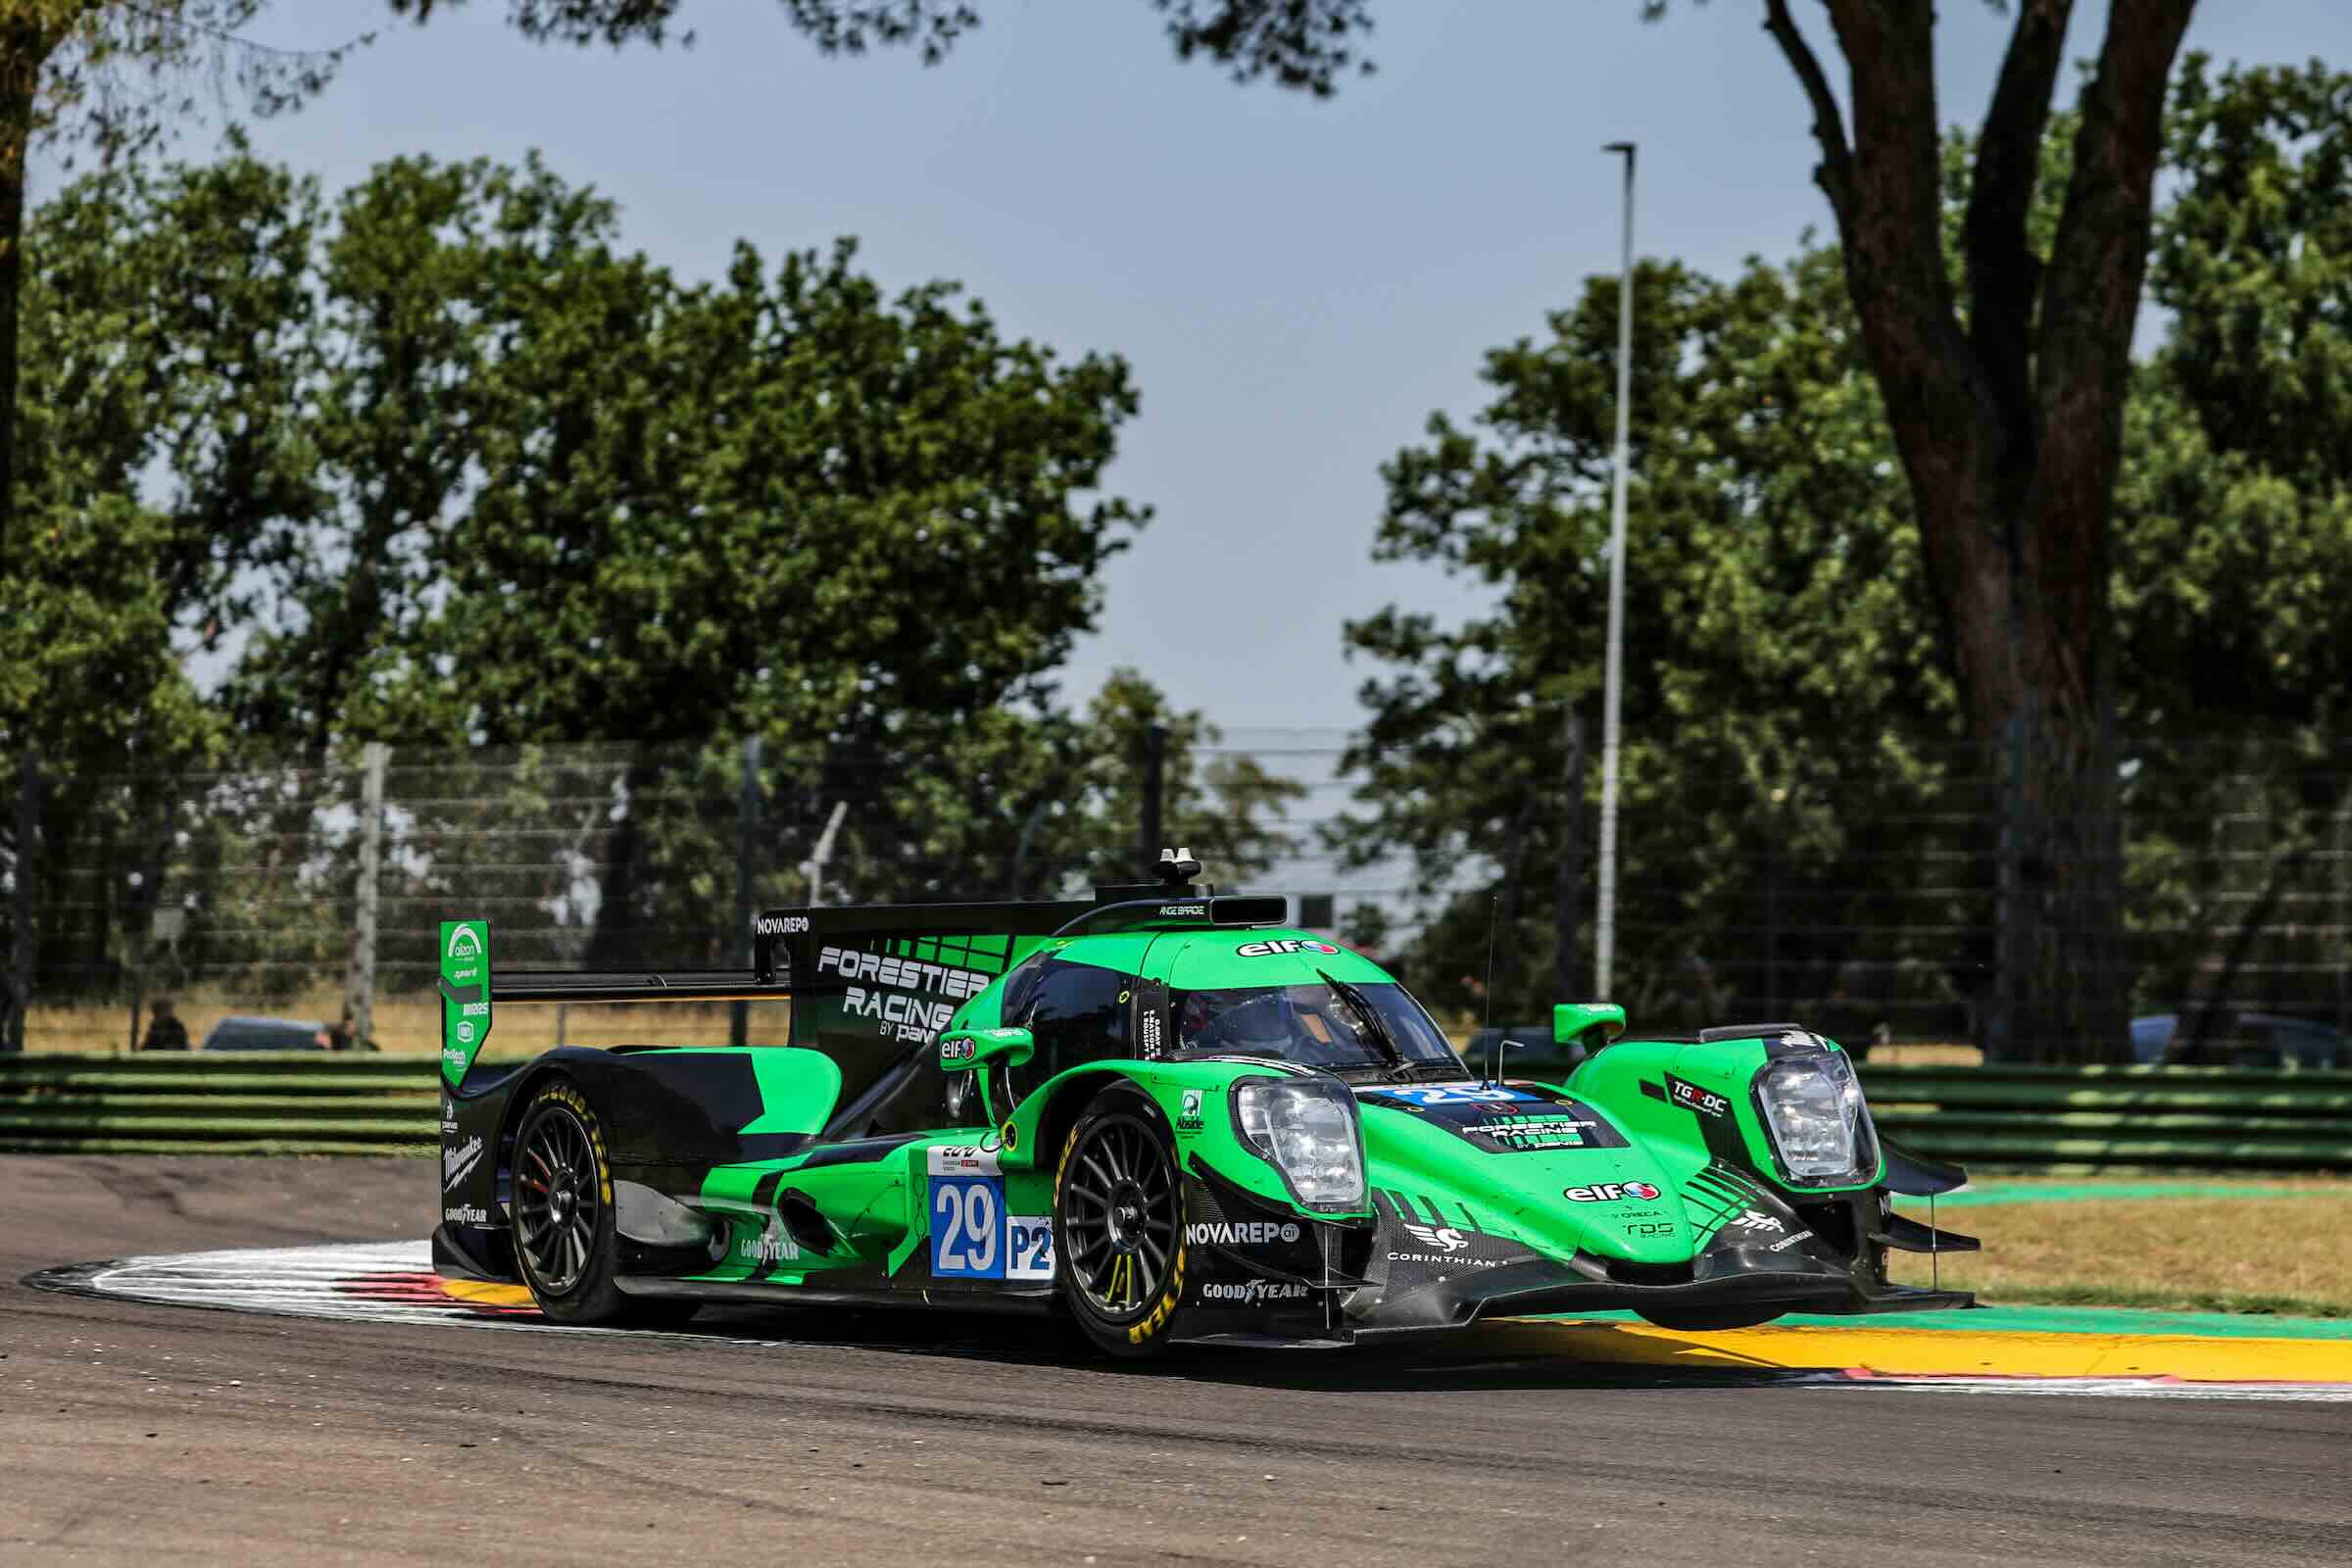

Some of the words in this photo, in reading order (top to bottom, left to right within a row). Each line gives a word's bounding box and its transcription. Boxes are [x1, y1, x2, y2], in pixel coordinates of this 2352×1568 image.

[1238, 940, 1298, 956] elf
[817, 946, 990, 999] FORESTIER
[843, 986, 955, 1030] RACING
[879, 1021, 894, 1035] BY
[942, 1040, 960, 1057] elf
[1462, 1121, 1597, 1134] FORESTIER
[1492, 1127, 1579, 1138] RACING
[1564, 1183, 1624, 1201] elf
[937, 1184, 997, 1271] 29
[741, 1235, 800, 1263] GOODYEAR
[1011, 1225, 1053, 1270] P2
[1388, 1251, 1496, 1268] CORINTHIAN
[1202, 1280, 1309, 1301] GOODYEAR
